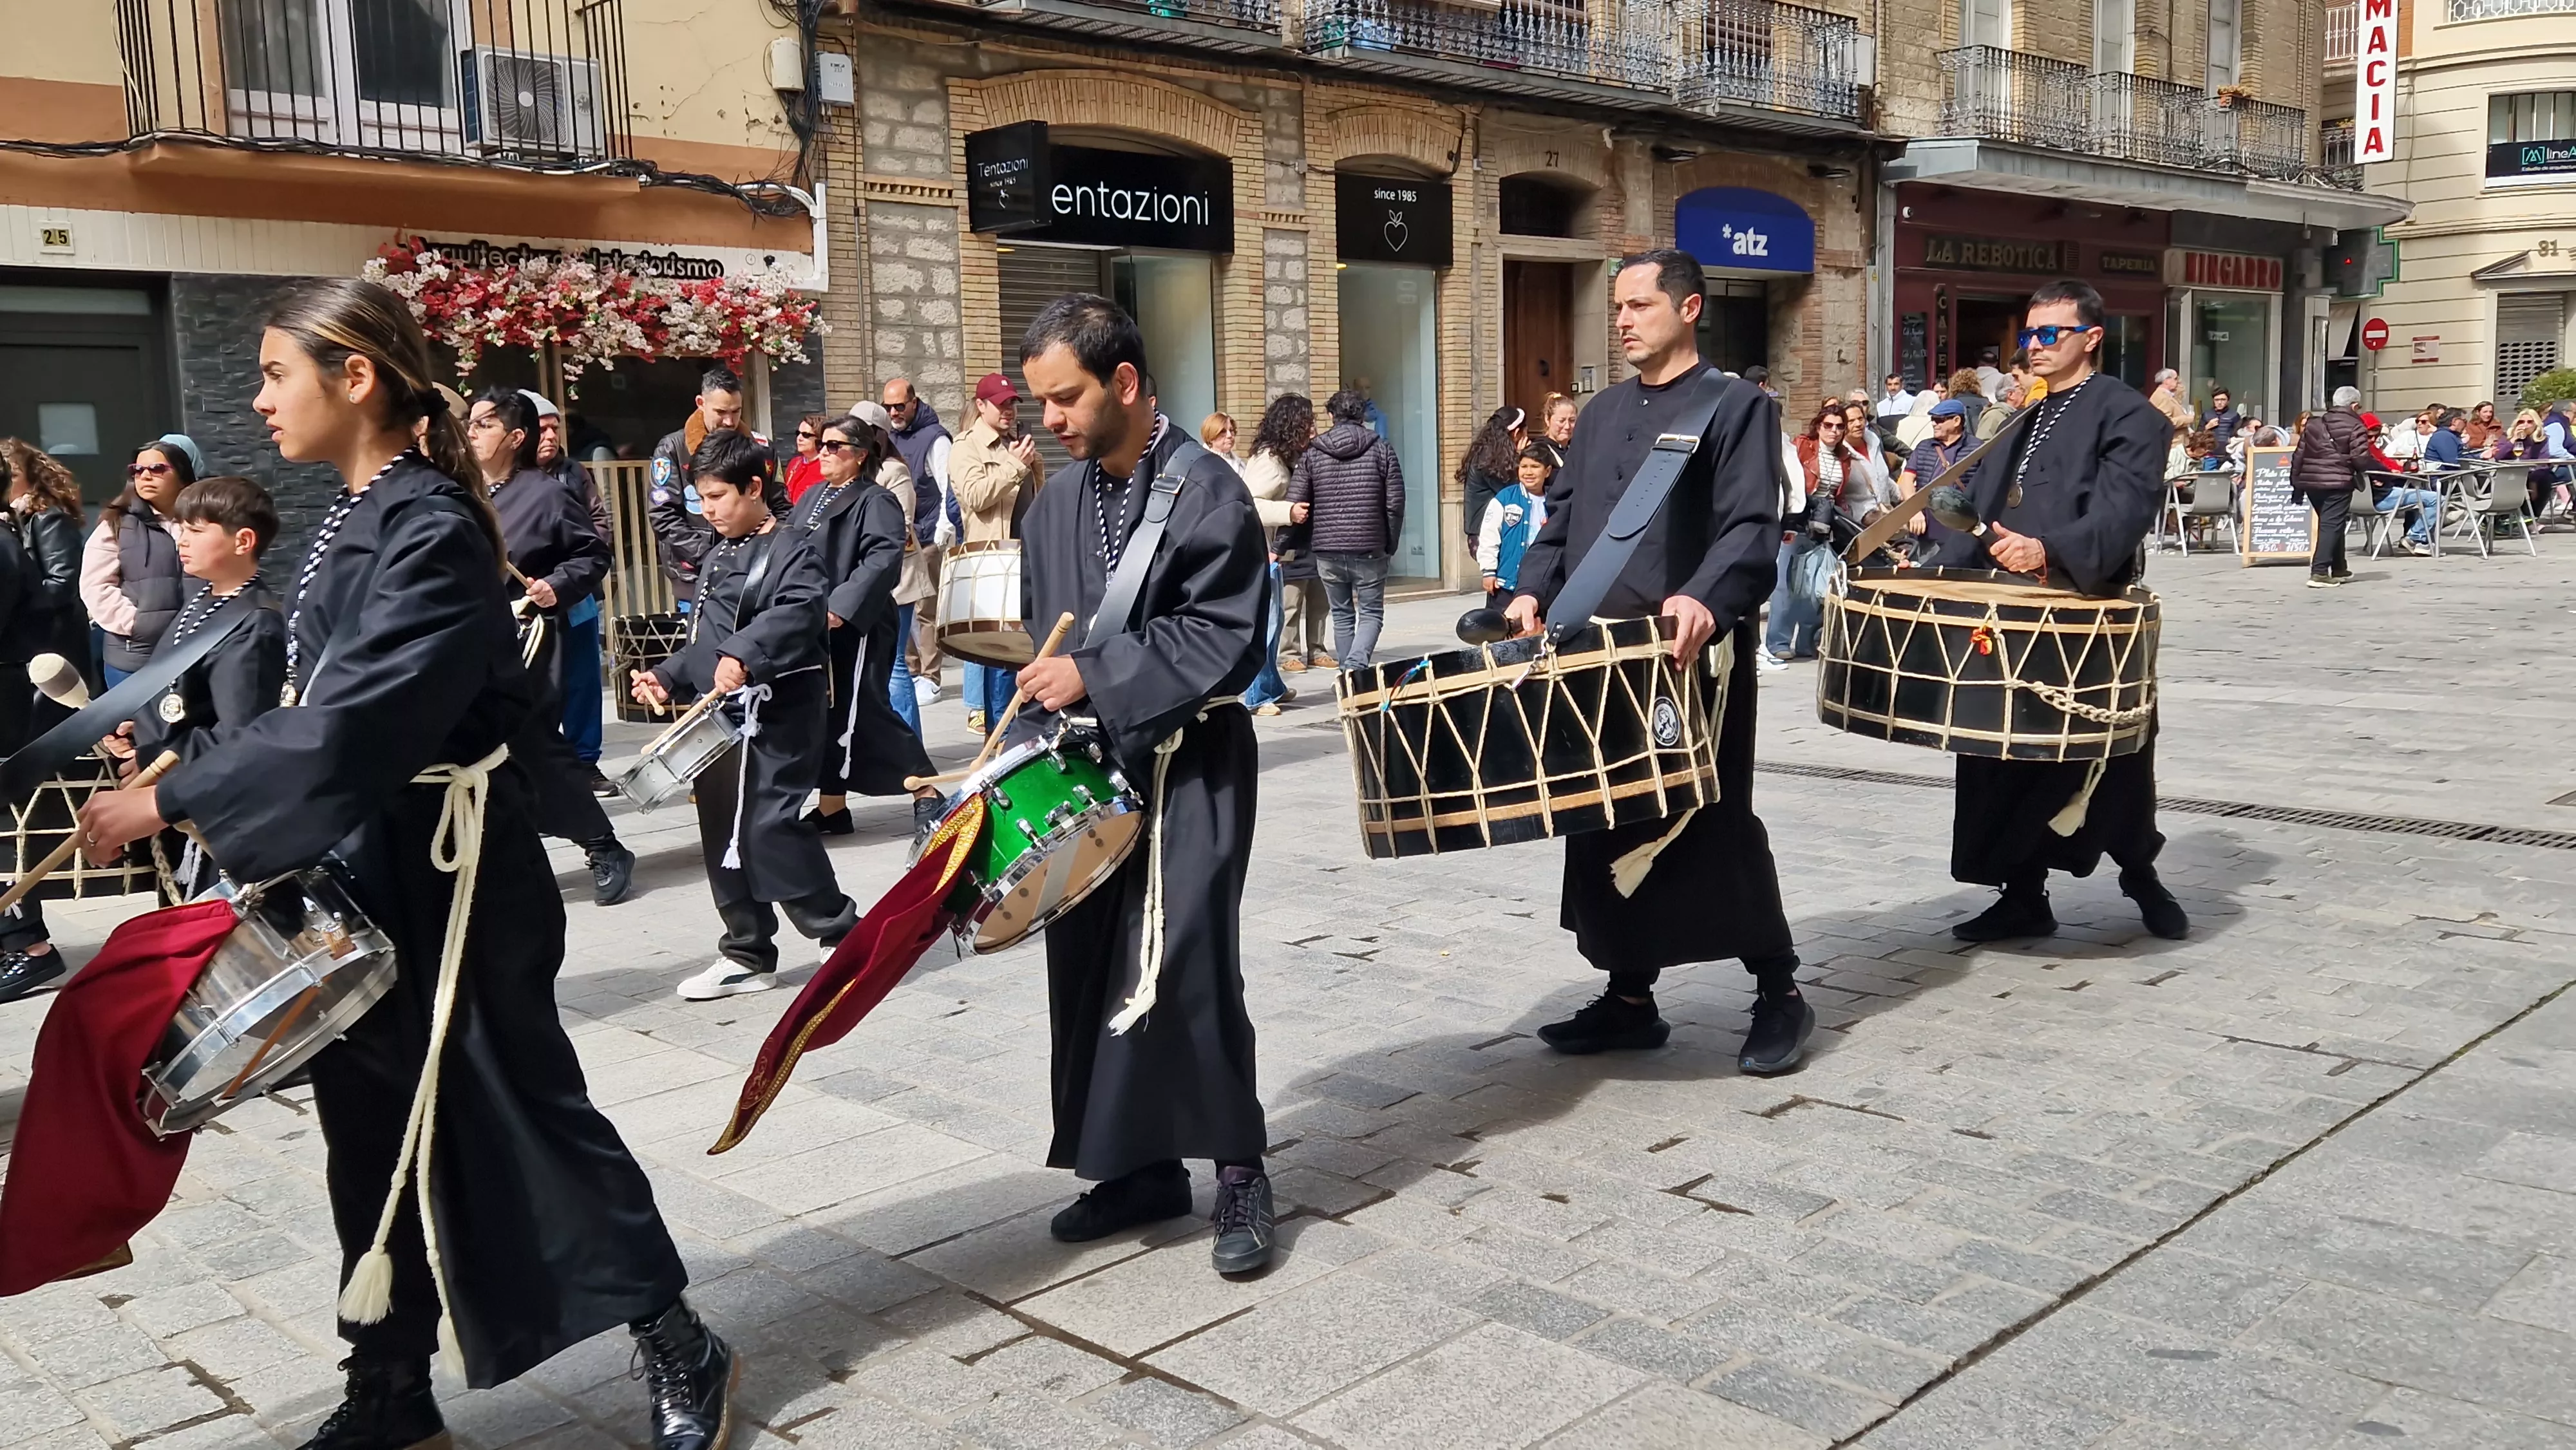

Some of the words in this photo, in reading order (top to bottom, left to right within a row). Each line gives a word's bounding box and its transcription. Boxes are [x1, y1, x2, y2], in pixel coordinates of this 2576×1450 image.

[977, 158, 1028, 178] Tentazioni
[1545, 151, 1559, 167] 27
[1051, 180, 1208, 225] entazioni
[1374, 187, 1396, 200] since
[1397, 189, 1417, 202] 1985
[43, 229, 68, 244] 25
[1926, 240, 1955, 263] LA
[1960, 243, 2058, 270] REBOTICA
